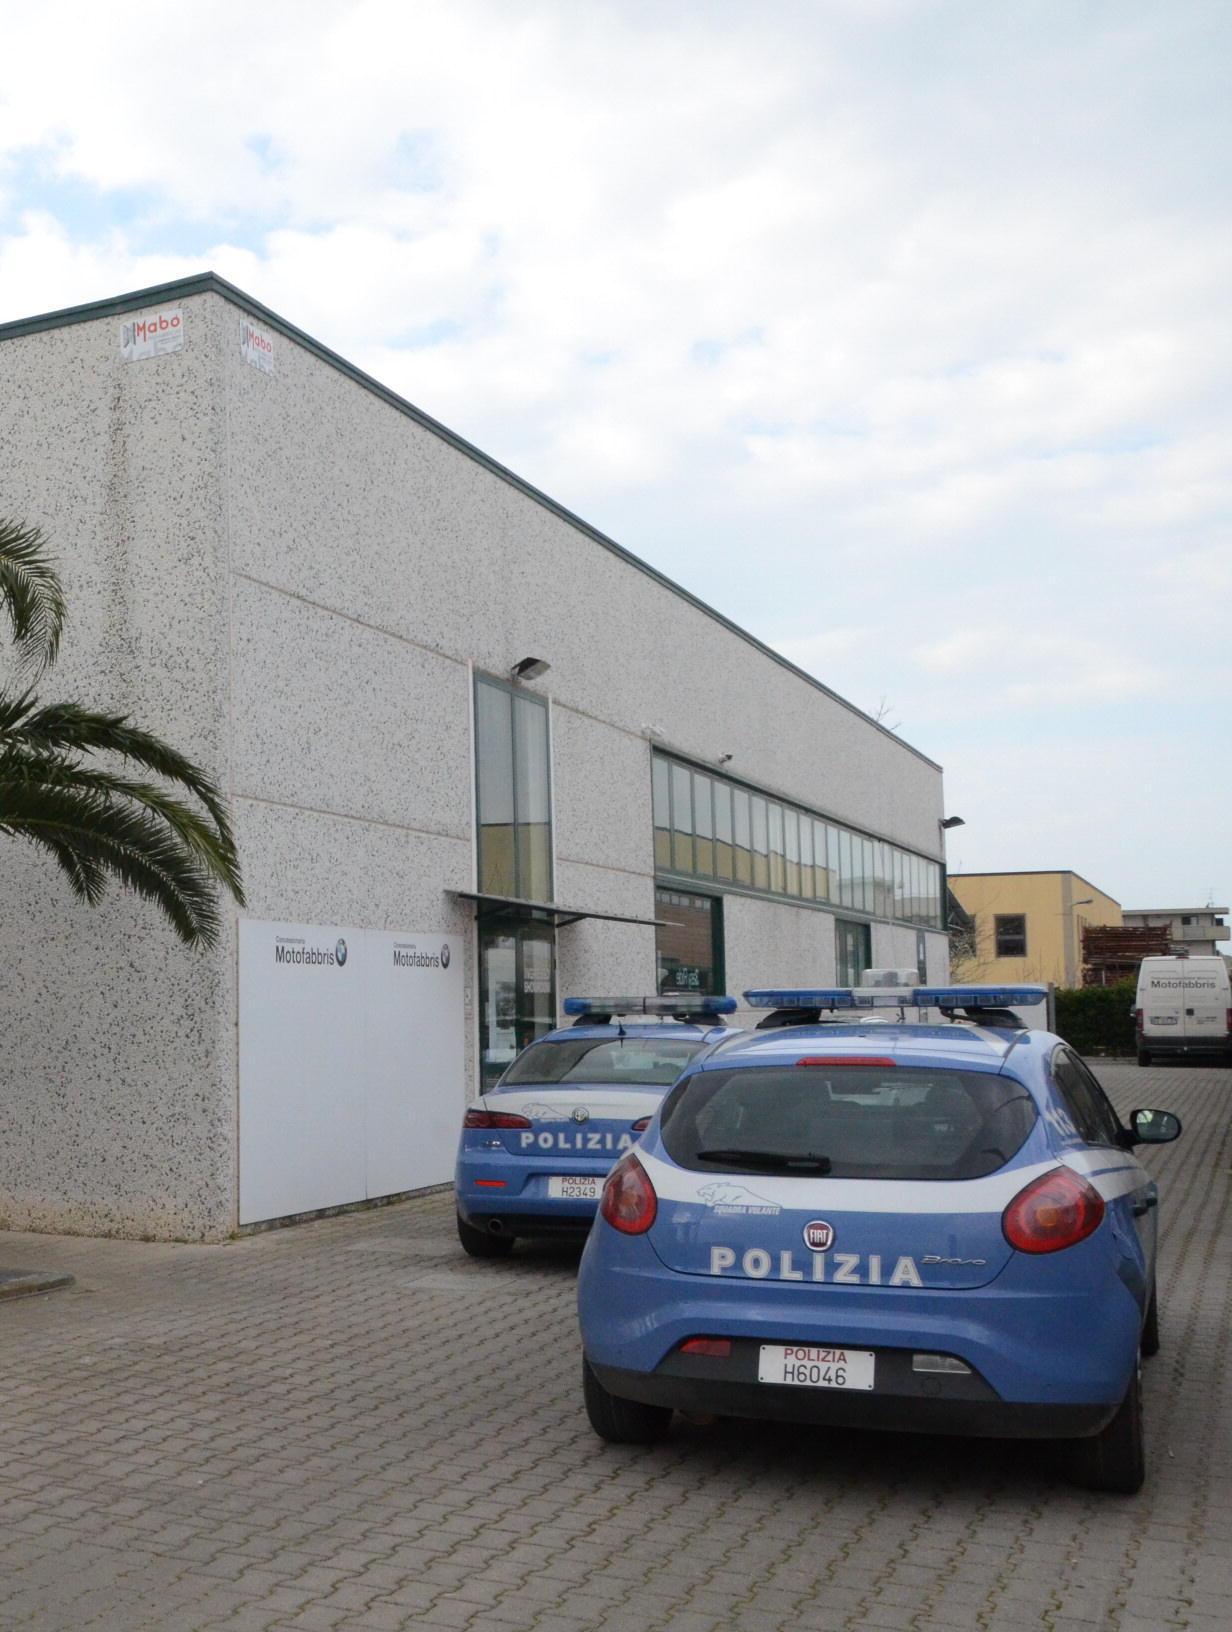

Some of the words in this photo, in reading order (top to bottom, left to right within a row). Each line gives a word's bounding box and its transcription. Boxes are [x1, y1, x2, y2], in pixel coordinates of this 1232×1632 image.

[136, 314, 181, 343] Mabo
[275, 945, 335, 966] Motofabbris
[393, 950, 440, 968] Motofabbris
[1151, 980, 1216, 989] Motofabbris
[520, 1131, 633, 1150] POLIZIA
[561, 1177, 596, 1186] POLIZIA
[561, 1187, 596, 1198] H2349
[748, 1205, 781, 1215] VOLANTE
[809, 1229, 828, 1243] FIAT
[710, 1246, 923, 1288] POLIZIA
[783, 1348, 848, 1365] POLIZIA
[783, 1363, 847, 1387] H6046
